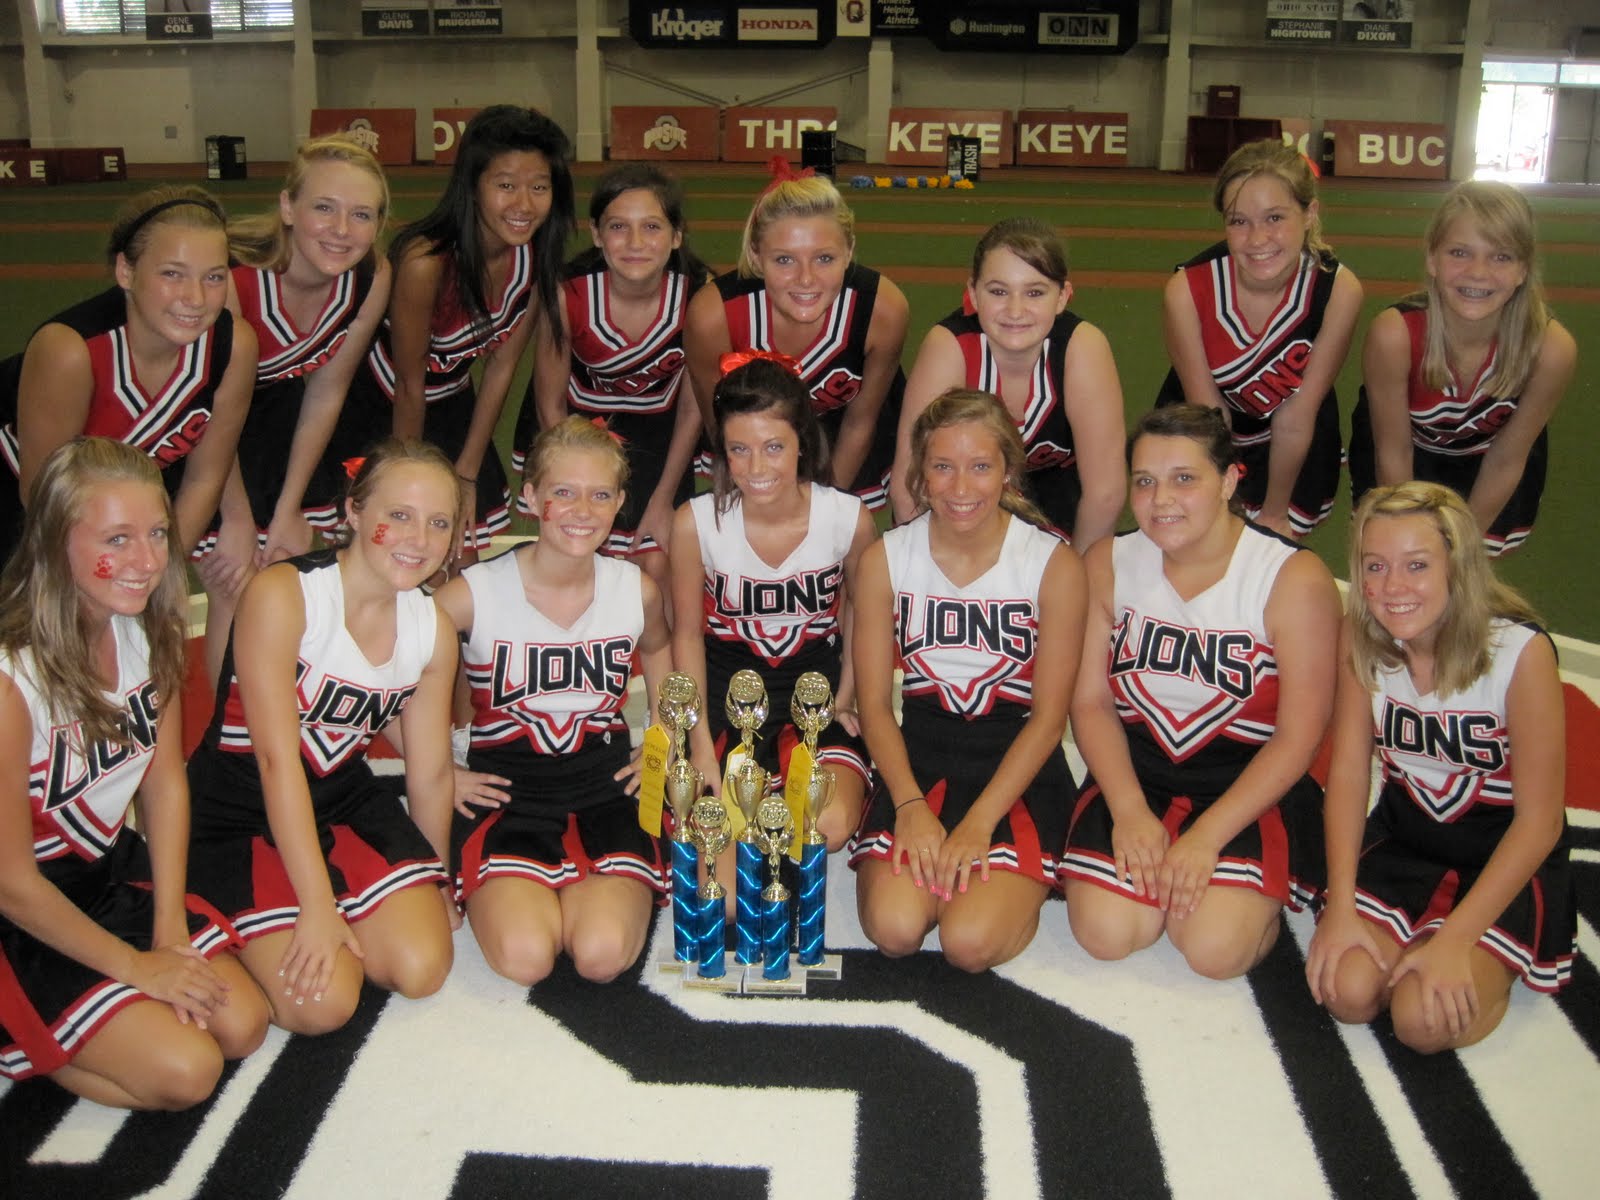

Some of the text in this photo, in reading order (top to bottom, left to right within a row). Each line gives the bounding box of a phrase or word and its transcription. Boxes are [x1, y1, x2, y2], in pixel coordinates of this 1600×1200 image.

[382, 12, 410, 20] GLENN
[450, 11, 486, 19] RICHARD
[883, 6, 915, 16] Helping
[378, 20, 414, 29] DAVIS
[438, 18, 499, 27] BRUGGEMAN
[652, 8, 724, 40] Kroger
[741, 19, 814, 30] HONDA
[885, 16, 919, 25] Athletes
[1048, 17, 1109, 36] ONN
[1278, 21, 1325, 30] STEPHANIE
[164, 24, 194, 33] COLE
[969, 21, 1026, 36] Huntington
[1271, 29, 1332, 39] HIGHTOWER
[1364, 24, 1390, 32] DIANE
[1357, 31, 1396, 41] DIXON
[739, 119, 838, 149] TH
[1020, 123, 1128, 155] KEYE
[1358, 133, 1446, 167] BUC
[964, 144, 978, 175] TRASH
[712, 562, 843, 618] LIONS
[899, 591, 1036, 665] LIONS
[1107, 606, 1256, 702] LIONS
[490, 634, 634, 710] LIONS
[1375, 695, 1506, 774] IONS
